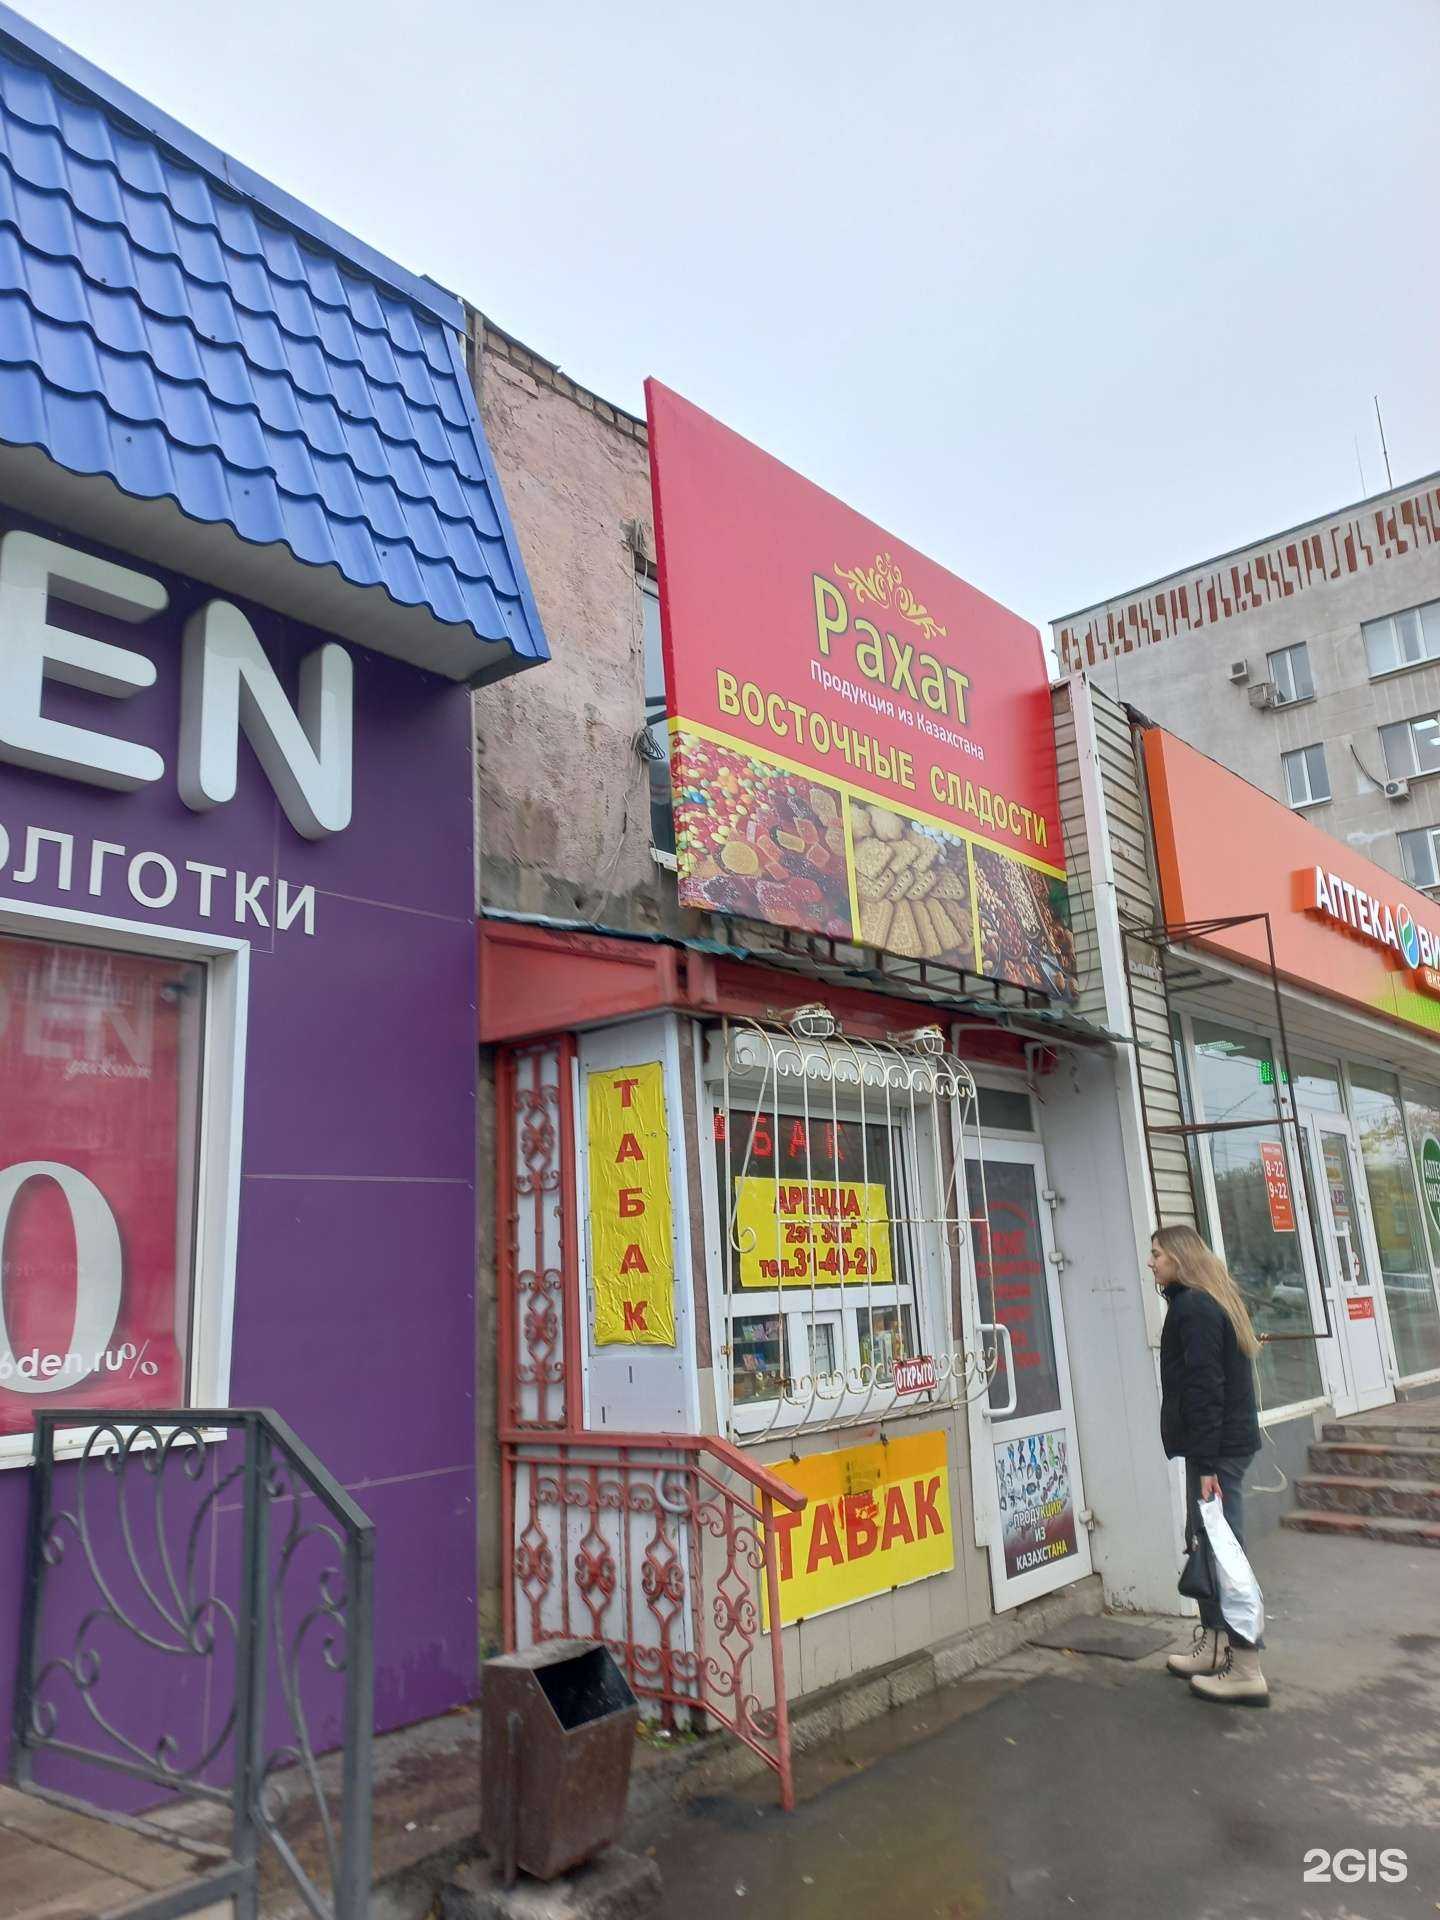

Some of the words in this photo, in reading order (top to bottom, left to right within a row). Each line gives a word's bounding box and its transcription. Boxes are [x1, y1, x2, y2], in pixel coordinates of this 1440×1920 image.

[812, 574, 969, 726] Рахат
[810, 659, 895, 719] Продукция
[897, 706, 914, 727] из
[916, 712, 985, 761] Казахстана
[716, 668, 916, 791] ВОСТОЧНЫЕ
[929, 765, 1048, 849] СЛАДОСТИ
[0, 822, 315, 936] ЛГОТКИ
[1315, 865, 1400, 951] АПТЕКА
[613, 1078, 650, 1332] ТАБАК
[773, 1186, 861, 1219] АРЕНДА
[1266, 1160, 1285, 1178] 8-22
[1269, 1182, 1288, 1199] 9-22
[897, 1362, 934, 1390] ОТКРЫТО
[773, 1475, 945, 1582] ТАБАК
[1016, 1539, 1068, 1571] КАЗАХСТАНА
[1034, 1526, 1046, 1542] ИЗ
